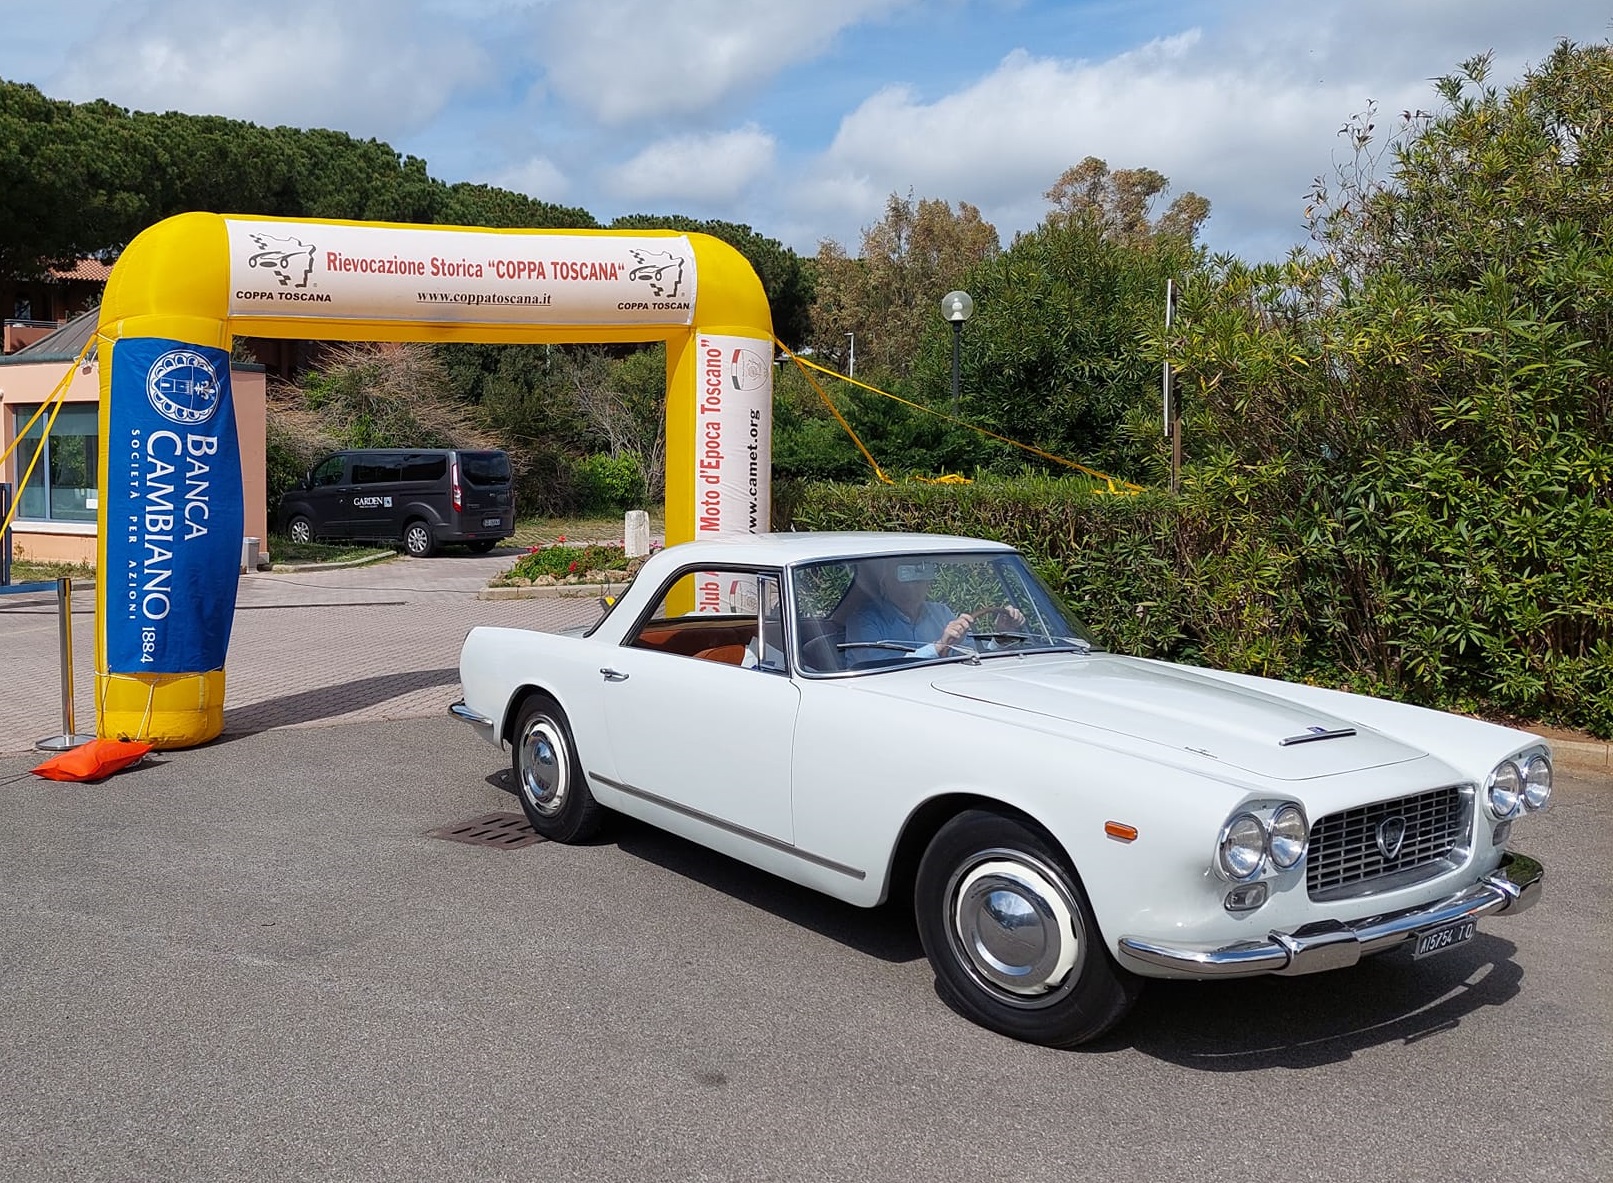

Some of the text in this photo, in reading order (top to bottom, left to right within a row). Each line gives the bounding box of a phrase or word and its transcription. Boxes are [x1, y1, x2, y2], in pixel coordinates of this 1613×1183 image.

[326, 251, 425, 276] Rievocazione
[430, 257, 483, 278] Storica
[236, 290, 332, 302] COPPA TOSCANA
[417, 290, 552, 306] www.coppatoscana.it
[617, 302, 649, 310] COPPA
[749, 409, 760, 534] ww.camet.org
[185, 433, 218, 541] BANCA
[353, 496, 383, 505] GARDEN
[128, 429, 140, 619] SOCIETÀ PER AZIONI
[700, 490, 721, 532] Moto
[141, 430, 182, 663] CAMBIANO 1884
[1459, 923, 1473, 940] TO
